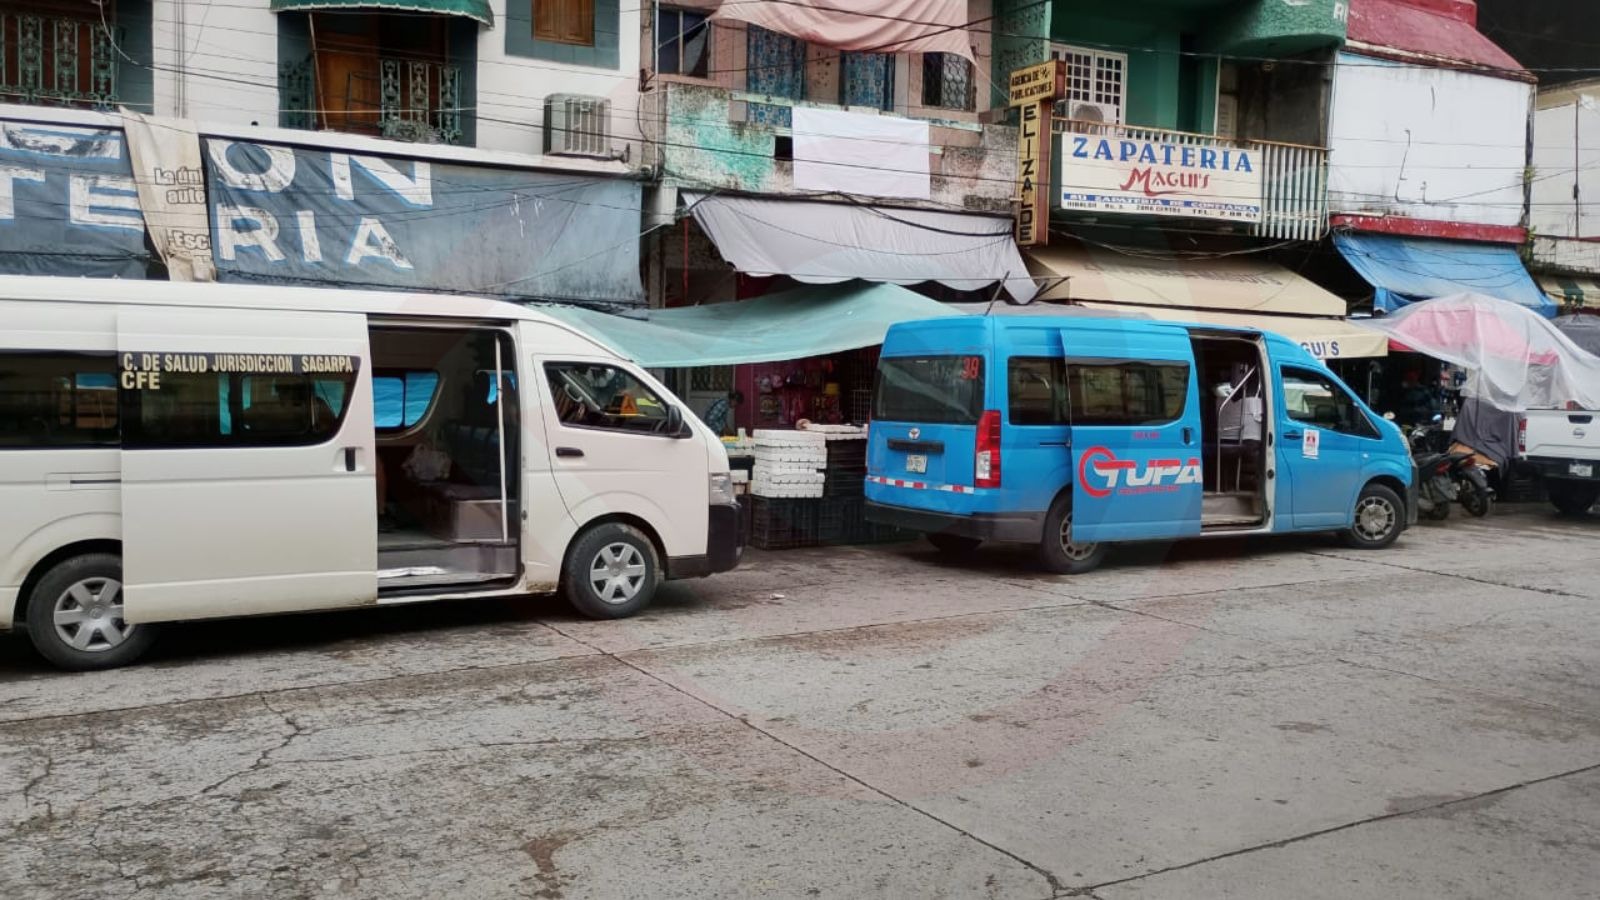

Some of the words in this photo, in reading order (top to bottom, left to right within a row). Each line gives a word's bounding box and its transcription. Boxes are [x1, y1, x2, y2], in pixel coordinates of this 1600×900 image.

[1072, 137, 1253, 173] ZAPATERIA
[154, 167, 175, 185] La
[1021, 104, 1037, 241] ELIZALDE
[123, 353, 138, 371] C.
[142, 354, 160, 371] DE
[164, 355, 207, 373] SALUD
[211, 354, 293, 373] JURISDICCION
[301, 355, 353, 373] SAGARPA
[121, 372, 161, 389] CFE
